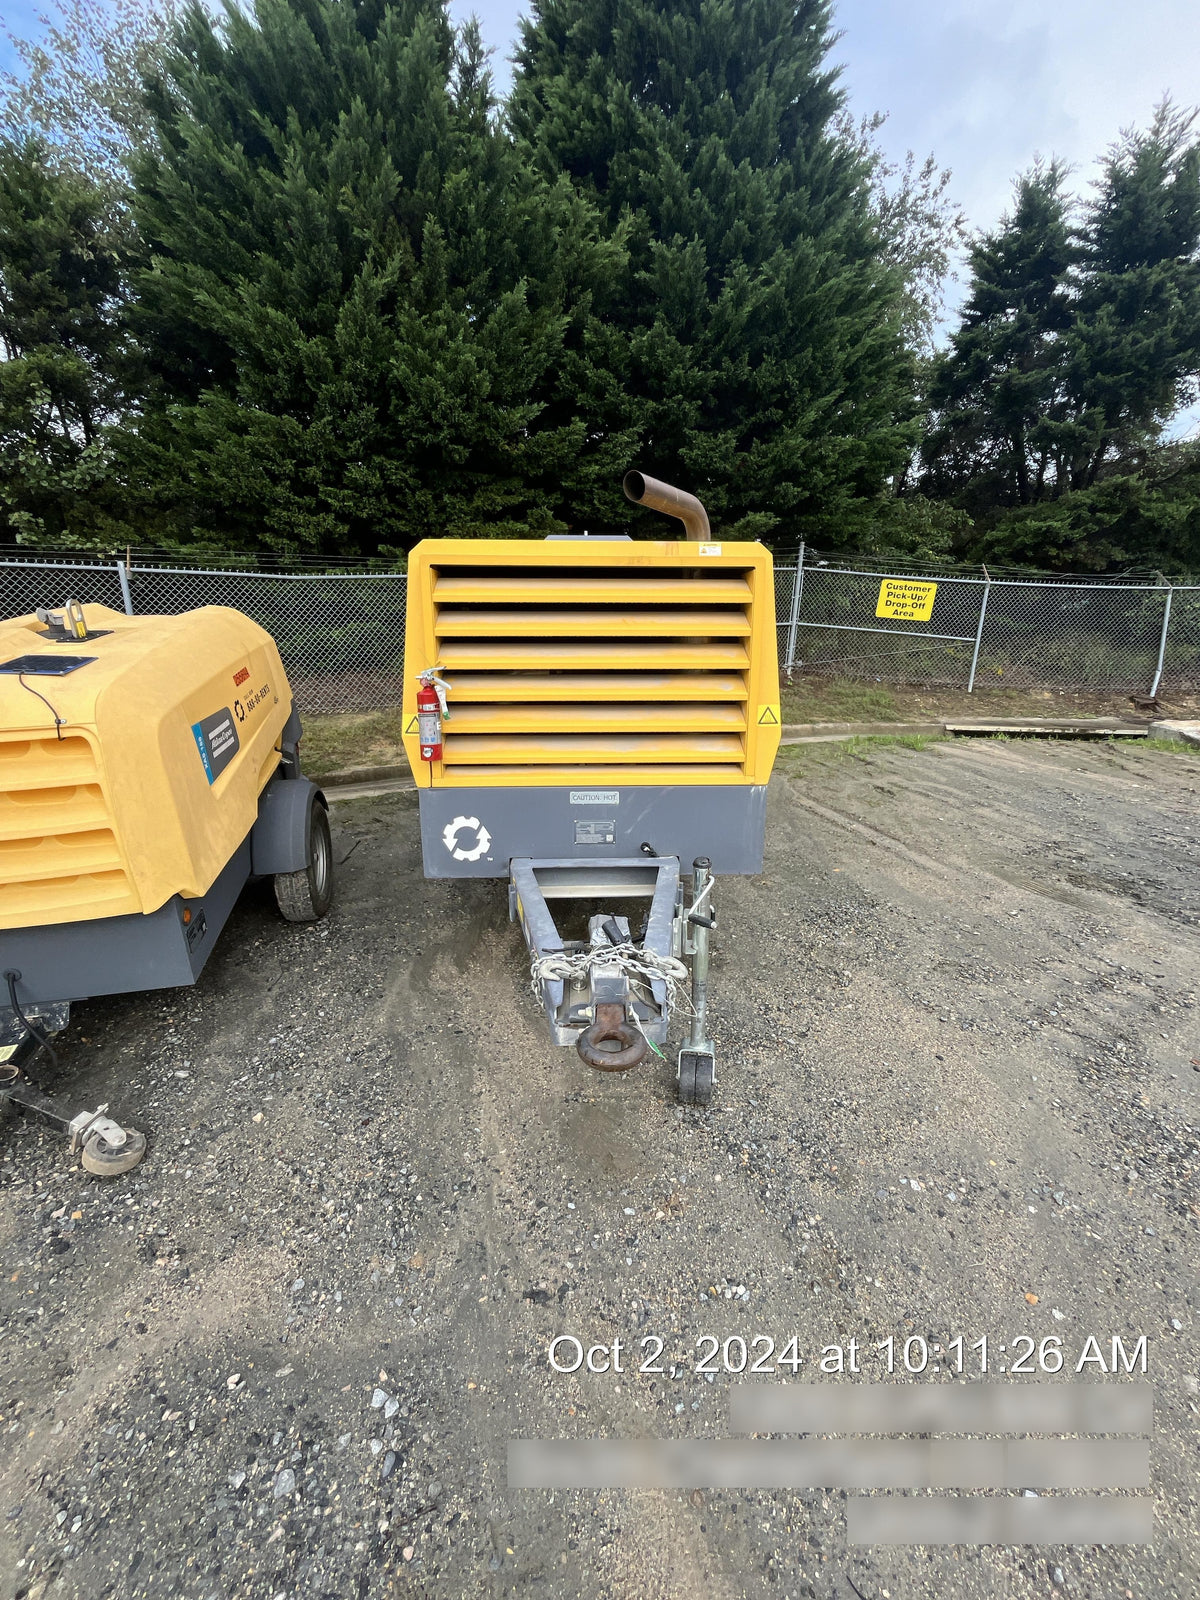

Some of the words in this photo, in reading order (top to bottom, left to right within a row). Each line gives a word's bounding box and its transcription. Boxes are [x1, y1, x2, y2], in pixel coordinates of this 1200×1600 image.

[886, 582, 932, 592] Customer
[887, 591, 928, 601] Pick-Up/
[885, 599, 926, 610] Drop-Off
[892, 609, 914, 617] Area
